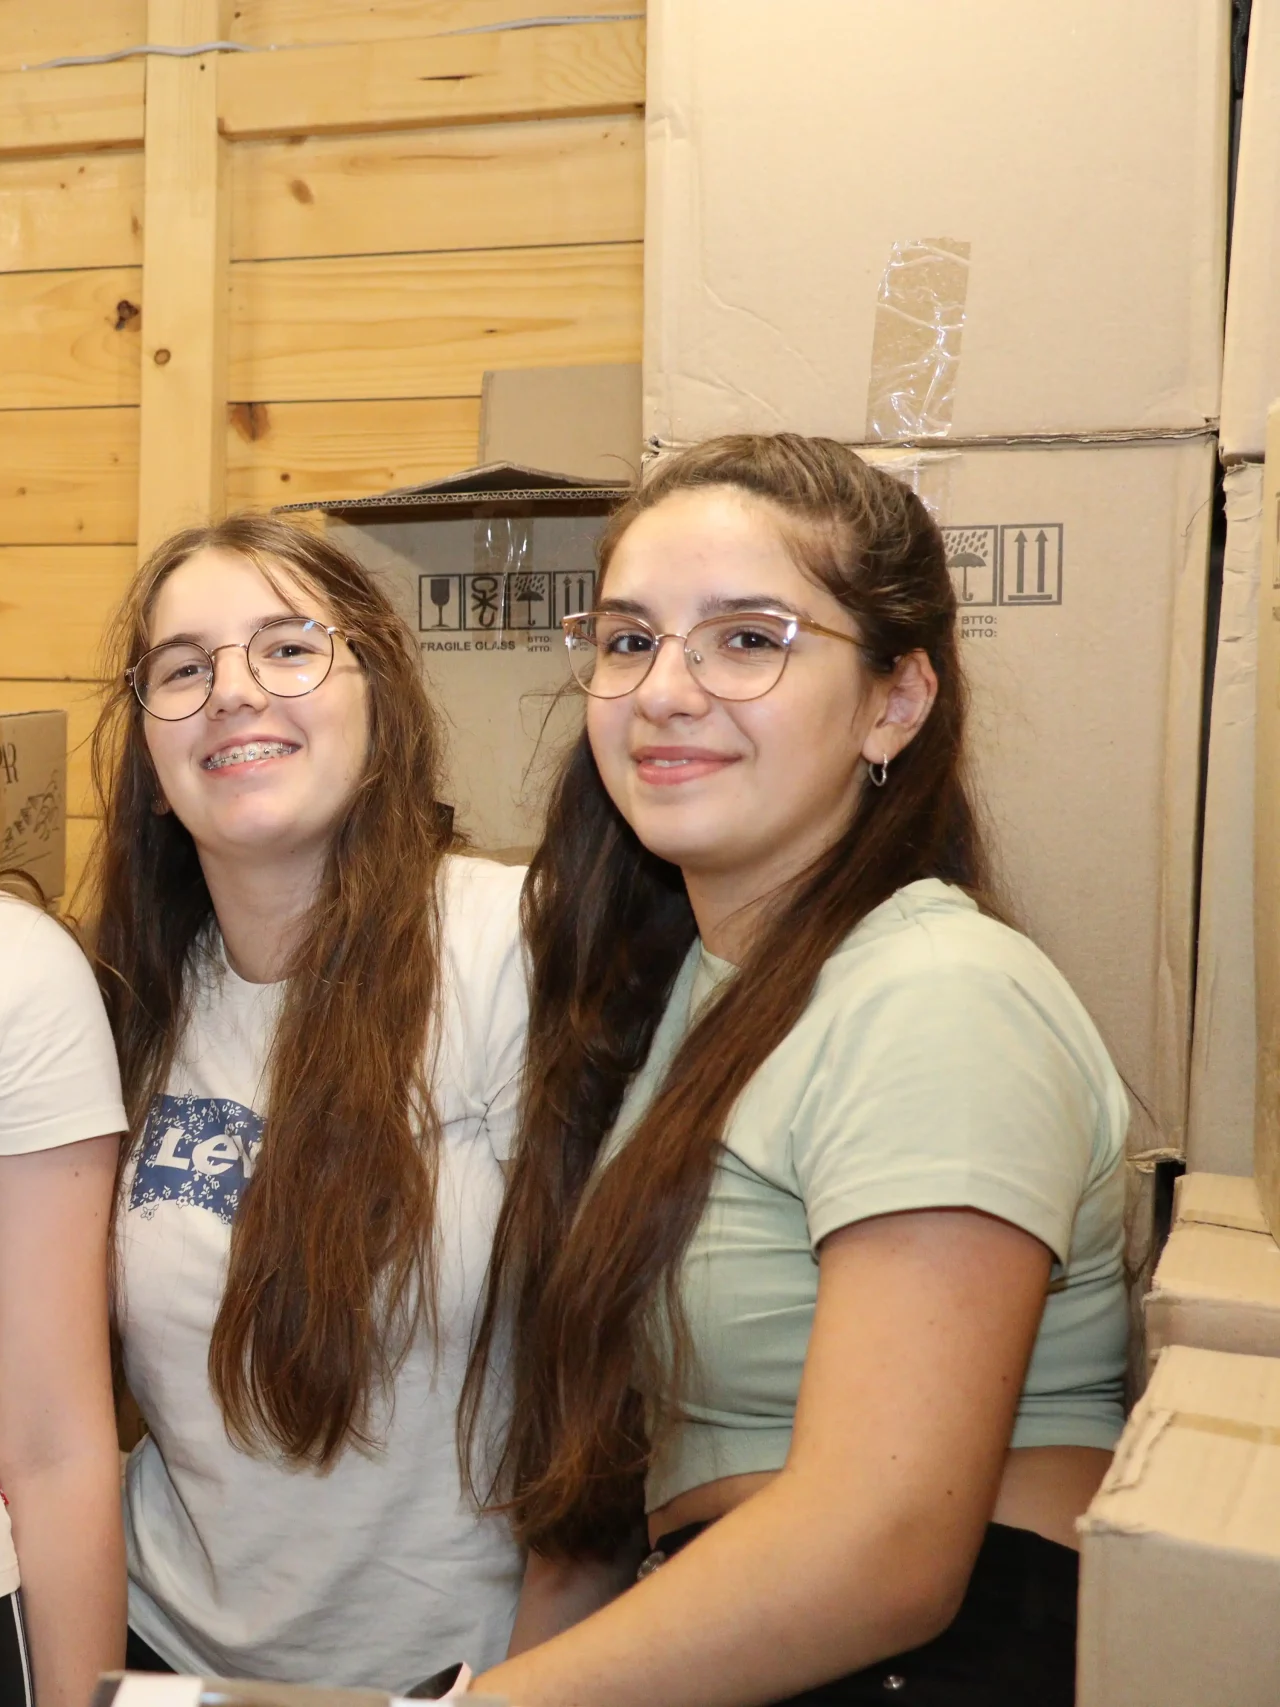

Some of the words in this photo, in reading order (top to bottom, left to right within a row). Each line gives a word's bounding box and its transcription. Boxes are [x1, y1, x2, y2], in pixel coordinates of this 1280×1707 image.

[961, 615, 998, 625] BTTO:
[420, 641, 472, 652] FRAGILE
[475, 640, 516, 651] GLASS
[154, 1126, 263, 1179] Lev
